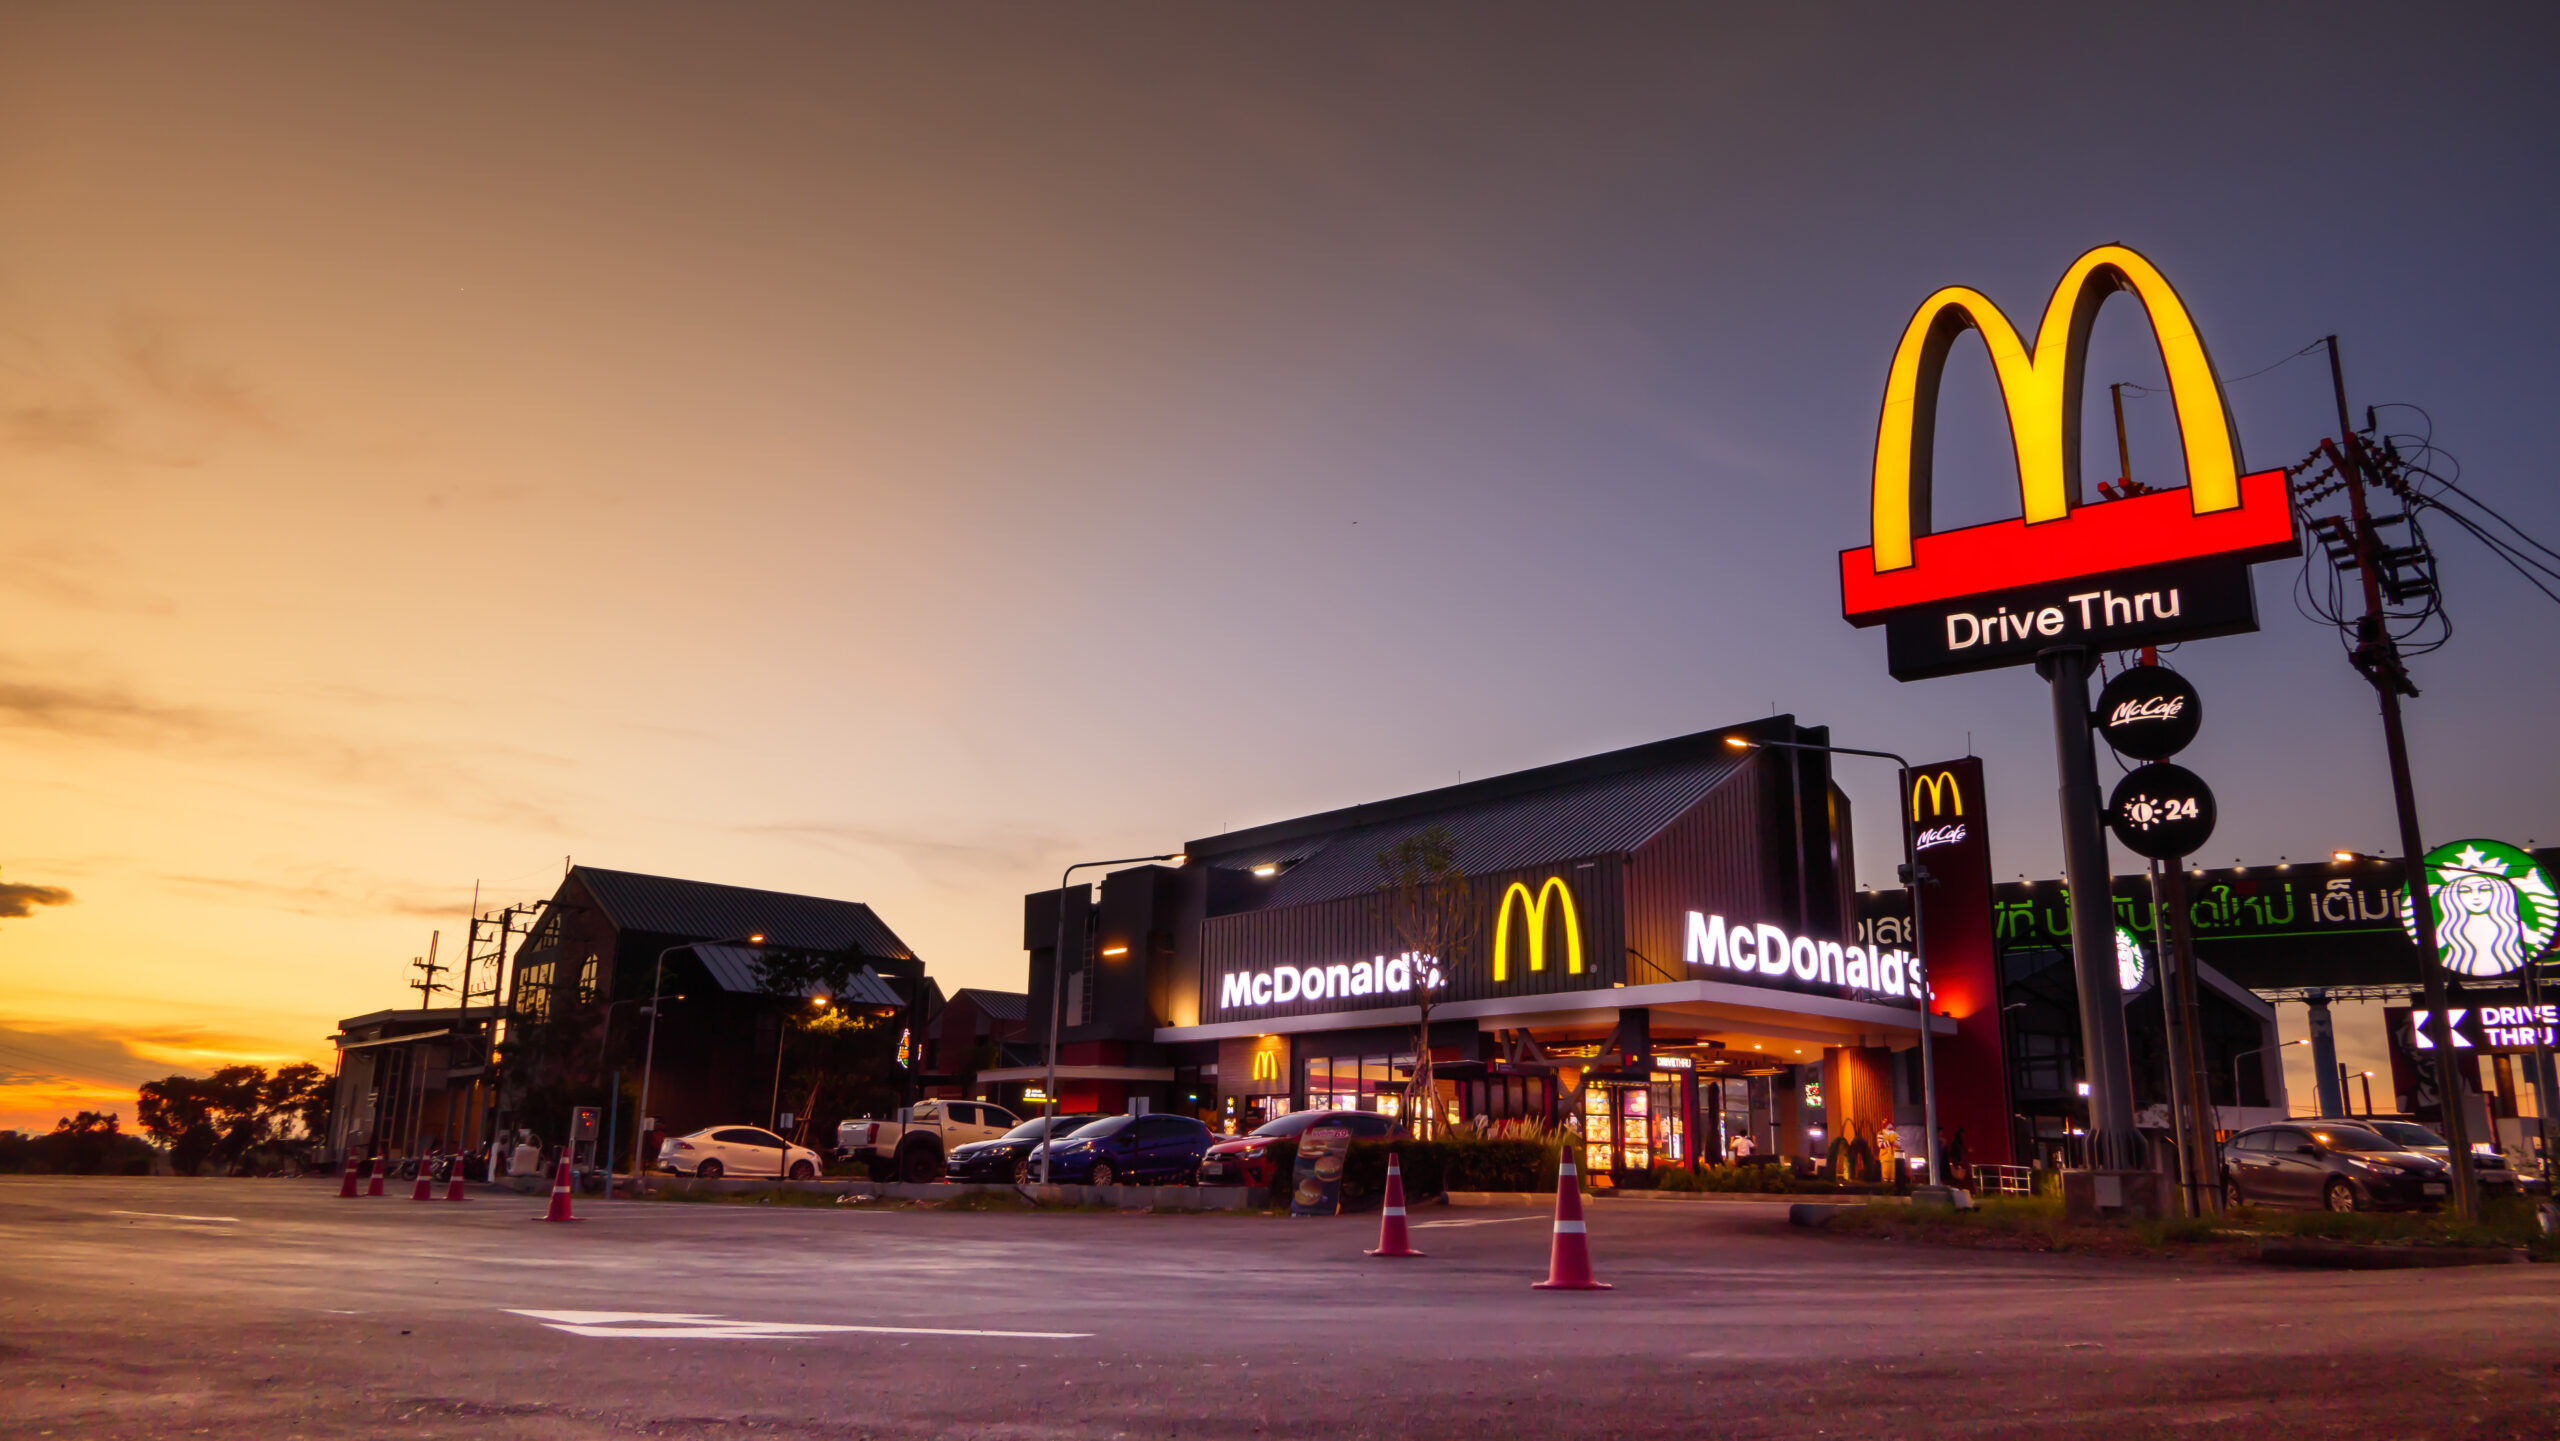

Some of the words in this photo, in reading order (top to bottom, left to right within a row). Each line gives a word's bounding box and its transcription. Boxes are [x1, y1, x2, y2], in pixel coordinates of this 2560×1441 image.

[1946, 606, 2065, 650] Drive
[2068, 589, 2180, 630] Thru
[2109, 695, 2184, 727] McCafé
[2164, 797, 2199, 821] 24
[1916, 823, 1967, 851] McCafé
[1683, 910, 1929, 1000] McDonald's
[2480, 1005, 2559, 1026] DRIVE
[2483, 1026, 2556, 1047] THRU
